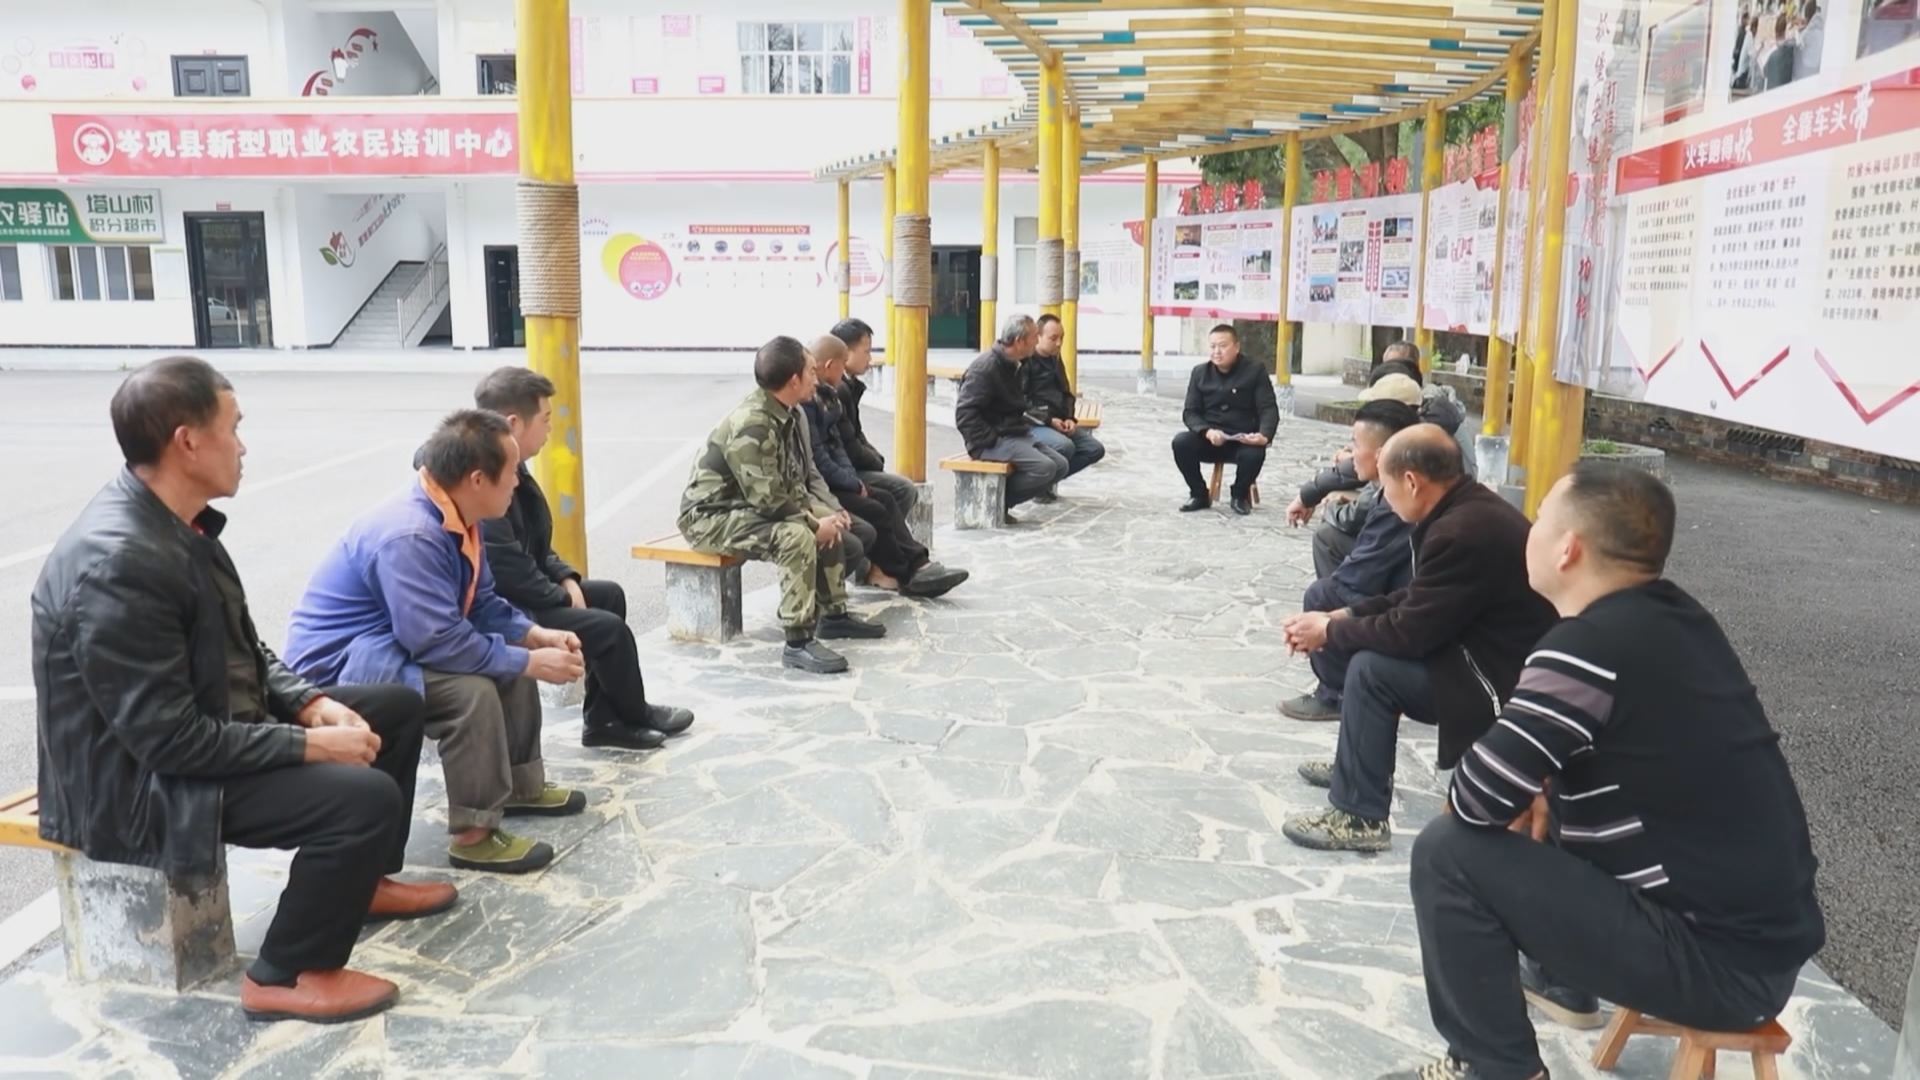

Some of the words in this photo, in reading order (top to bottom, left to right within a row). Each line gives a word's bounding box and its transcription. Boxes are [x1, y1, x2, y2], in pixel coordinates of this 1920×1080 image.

[1685, 119, 1753, 170] 火车跑得快
[1781, 80, 1875, 145] 全靠车头带
[115, 128, 512, 160] 岑巩县新型职业农民培训中心
[86, 194, 153, 214] 塔山村
[90, 218, 156, 232] 积分超市
